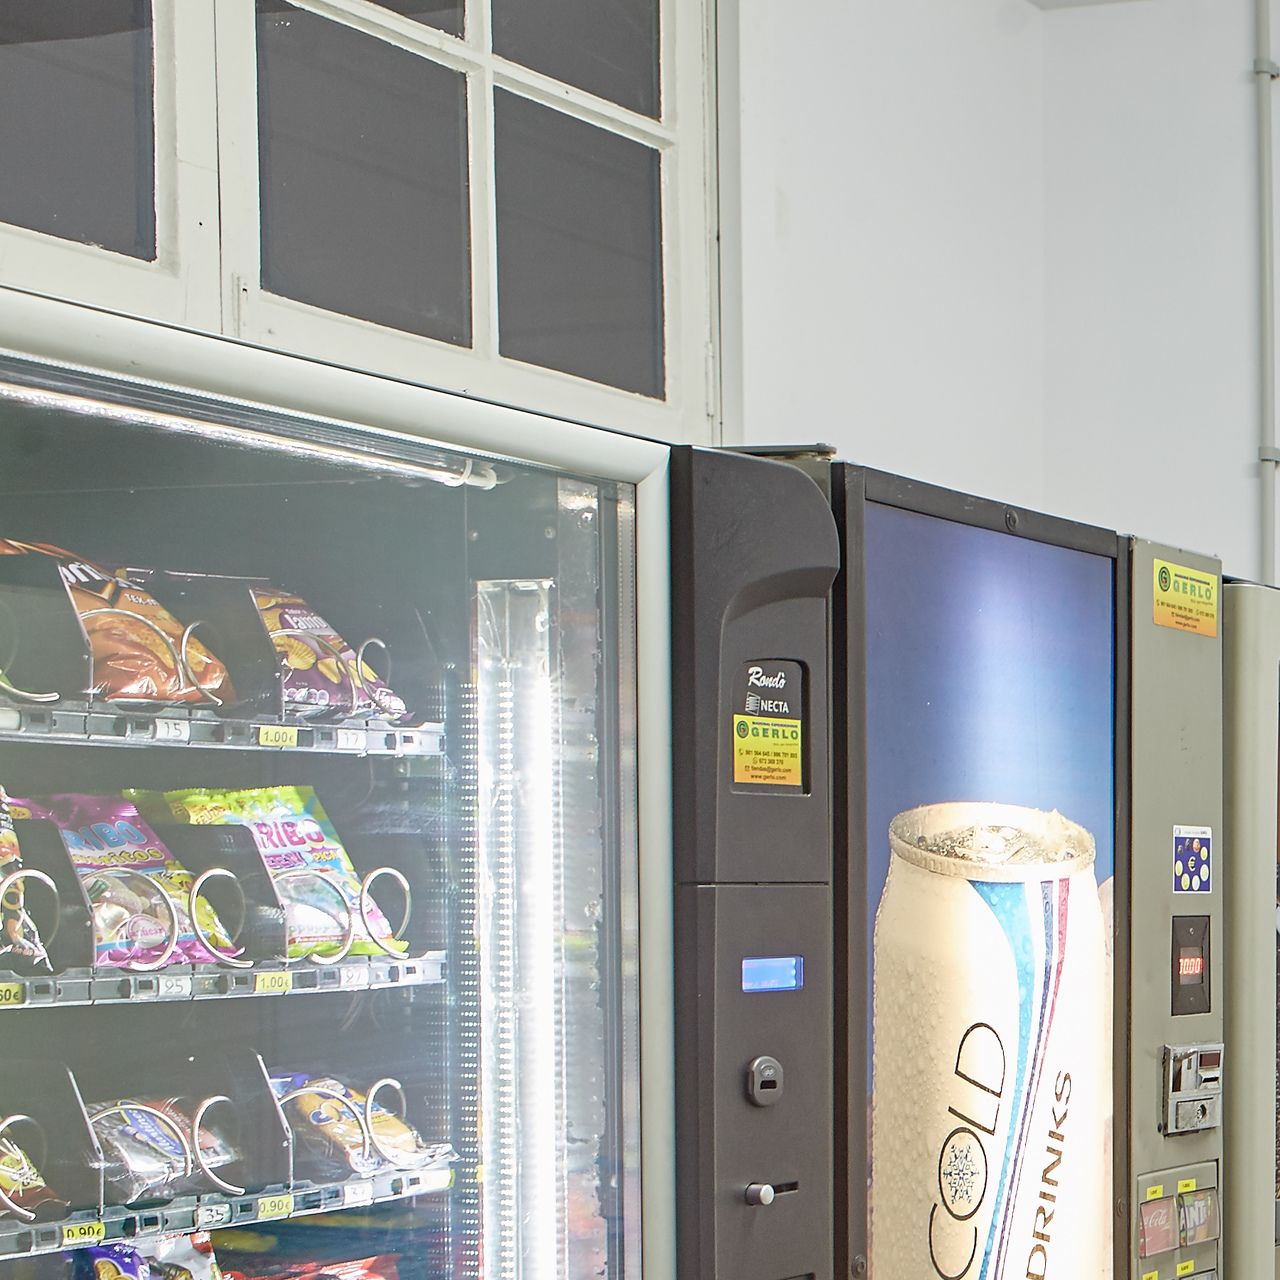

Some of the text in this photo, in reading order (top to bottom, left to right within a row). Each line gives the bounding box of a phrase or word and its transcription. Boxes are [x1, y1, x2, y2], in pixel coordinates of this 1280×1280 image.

[1173, 580, 1212, 600] GERLO
[761, 699, 789, 714] NECTA
[164, 722, 182, 737] 15
[751, 727, 799, 740] GERLO
[264, 731, 294, 744] 1.00€
[63, 821, 147, 850] RIBO
[255, 819, 325, 849] RIBO
[164, 979, 184, 994] 25
[259, 977, 289, 989] 1.00€
[259, 1200, 291, 1213] 0.90€
[205, 1208, 224, 1223] 35
[66, 1226, 102, 1239] 0.90€
